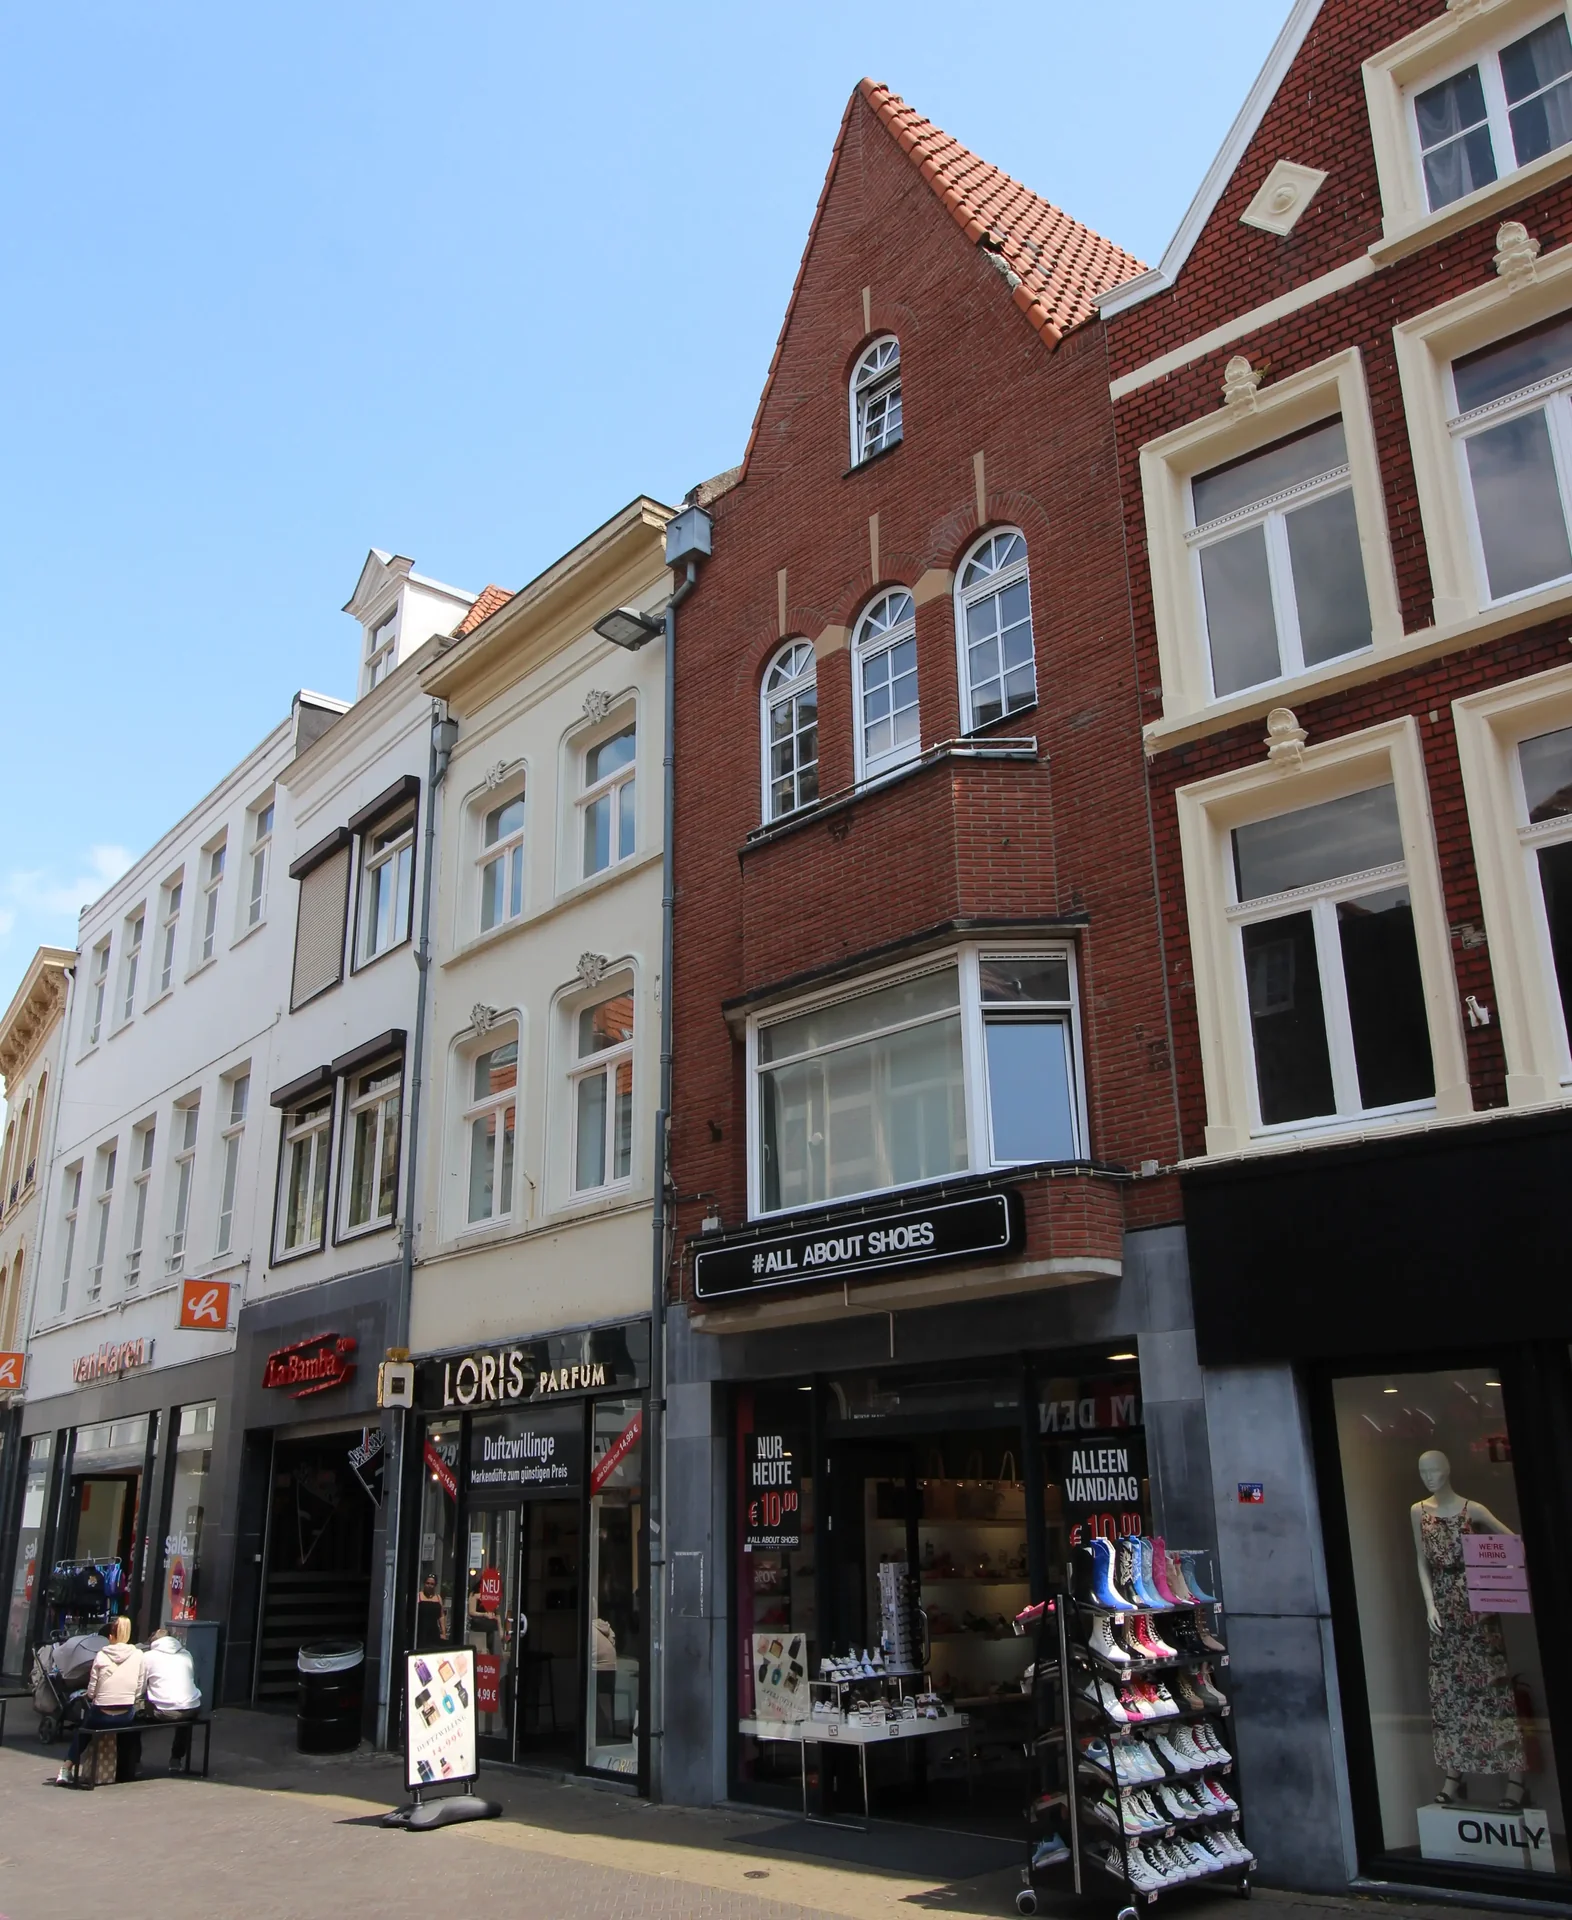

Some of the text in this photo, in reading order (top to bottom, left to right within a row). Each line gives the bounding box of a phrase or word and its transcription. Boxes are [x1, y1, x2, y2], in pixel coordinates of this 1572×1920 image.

[752, 1222, 935, 1274] #ALL ABOUT SHOES
[289, 1348, 337, 1383] Bamba
[444, 1351, 605, 1406] LORIS PARFUM
[484, 1432, 555, 1463] Duftzwillinge
[757, 1435, 783, 1460] NUR
[471, 1463, 568, 1484] Markendüfte zum günstigen Preis
[752, 1461, 792, 1485] HEUTE
[1072, 1449, 1129, 1474] ALLEEN
[1065, 1476, 1139, 1502] VANDAAG
[748, 1501, 758, 1527] €
[25, 1538, 38, 1560] sal
[165, 1530, 188, 1554] sale
[761, 1536, 780, 1544] ABOUT
[780, 1536, 799, 1544] SHOES
[1478, 1543, 1504, 1551] WE'RE
[482, 1579, 500, 1594] NEU
[477, 1689, 491, 1702] 4,99
[1458, 1820, 1545, 1850] ONLY
